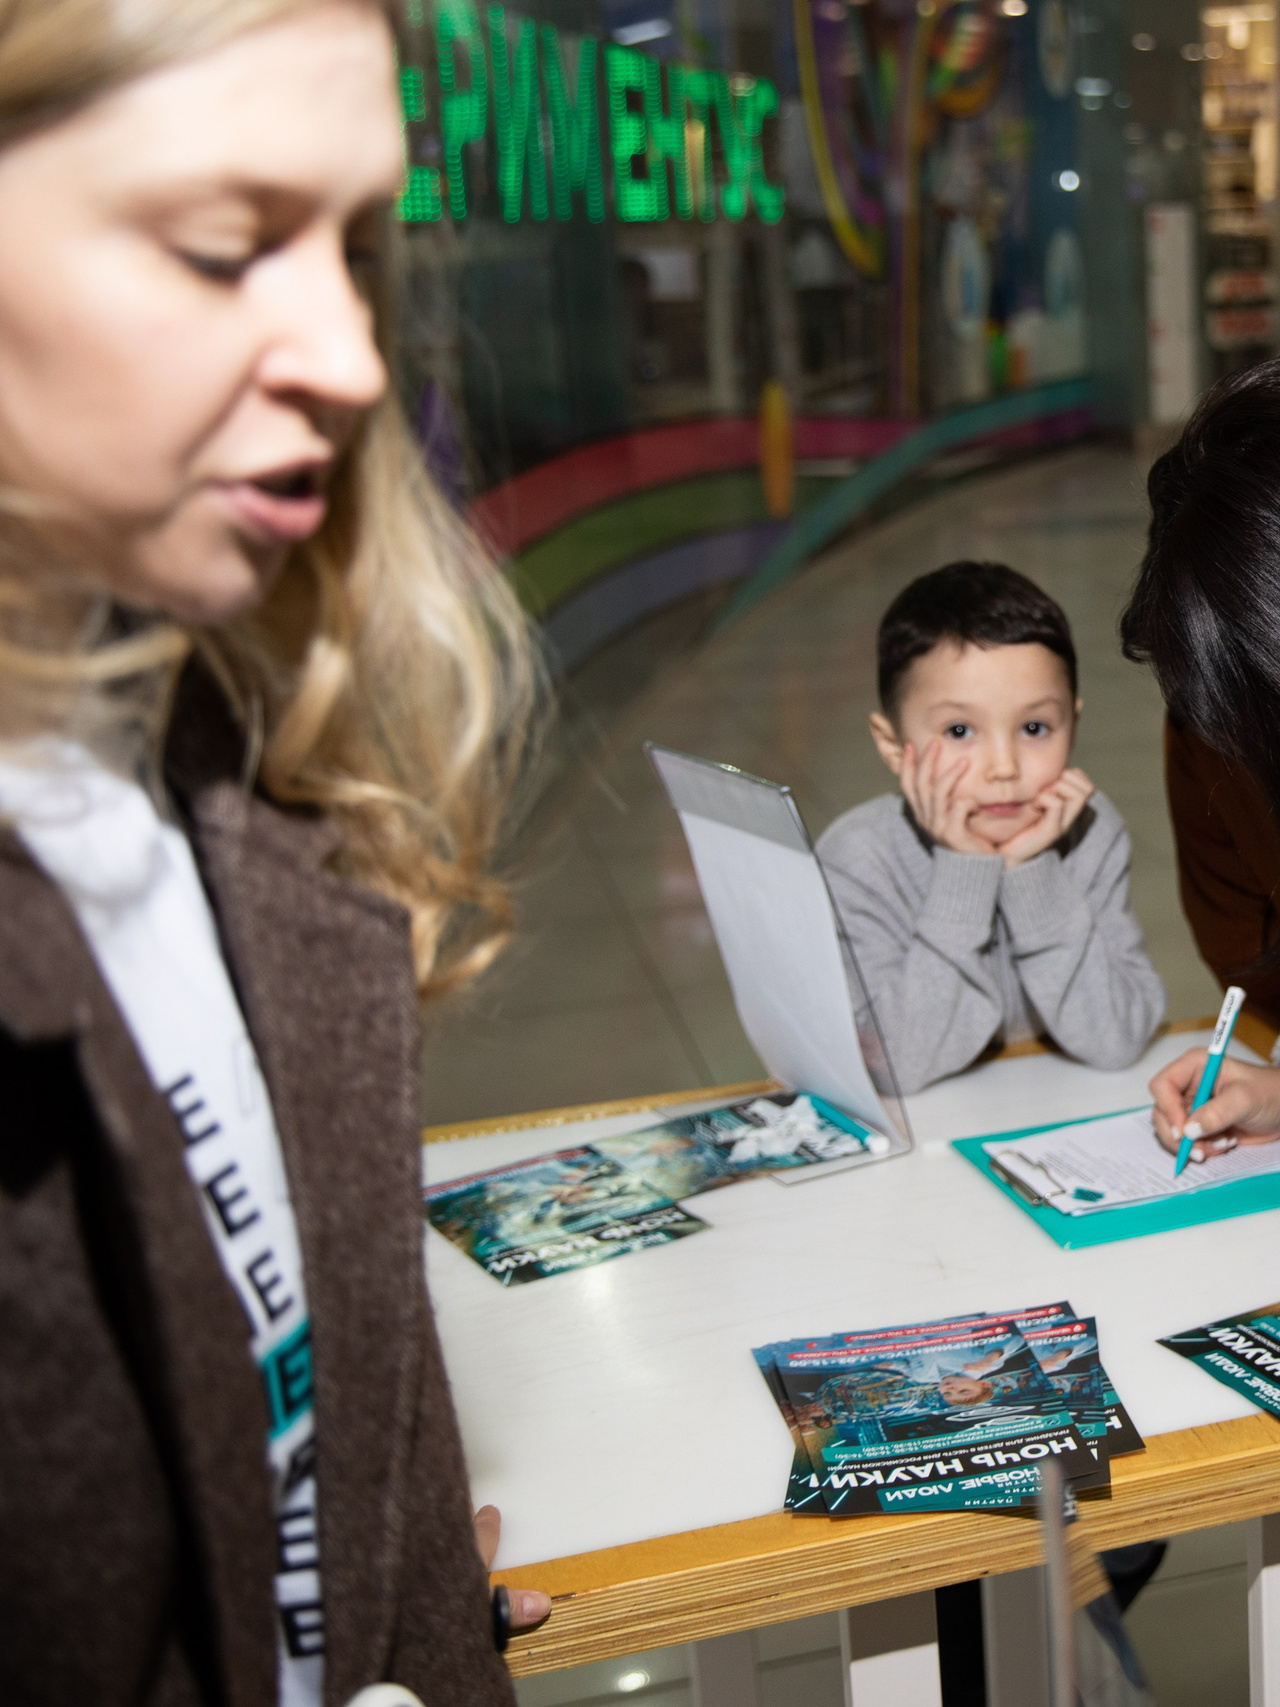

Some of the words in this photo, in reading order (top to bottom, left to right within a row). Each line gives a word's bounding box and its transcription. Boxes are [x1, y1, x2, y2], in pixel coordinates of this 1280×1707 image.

[484, 1233, 599, 1276] НАУКИ
[788, 1358, 828, 1368] 15:00
[1203, 1350, 1252, 1378] ЛЮДИ
[941, 1447, 969, 1458] ЧЕСТЬ
[968, 1435, 1077, 1469] НОЧЬ
[975, 1441, 1004, 1452] ДЕТЕЙ
[1003, 1437, 1023, 1446] ДЛЯ
[828, 1457, 964, 1489] НАУКИ
[957, 1465, 1041, 1489] НОВЫЕ
[883, 1481, 953, 1502] ЛЮДИ
